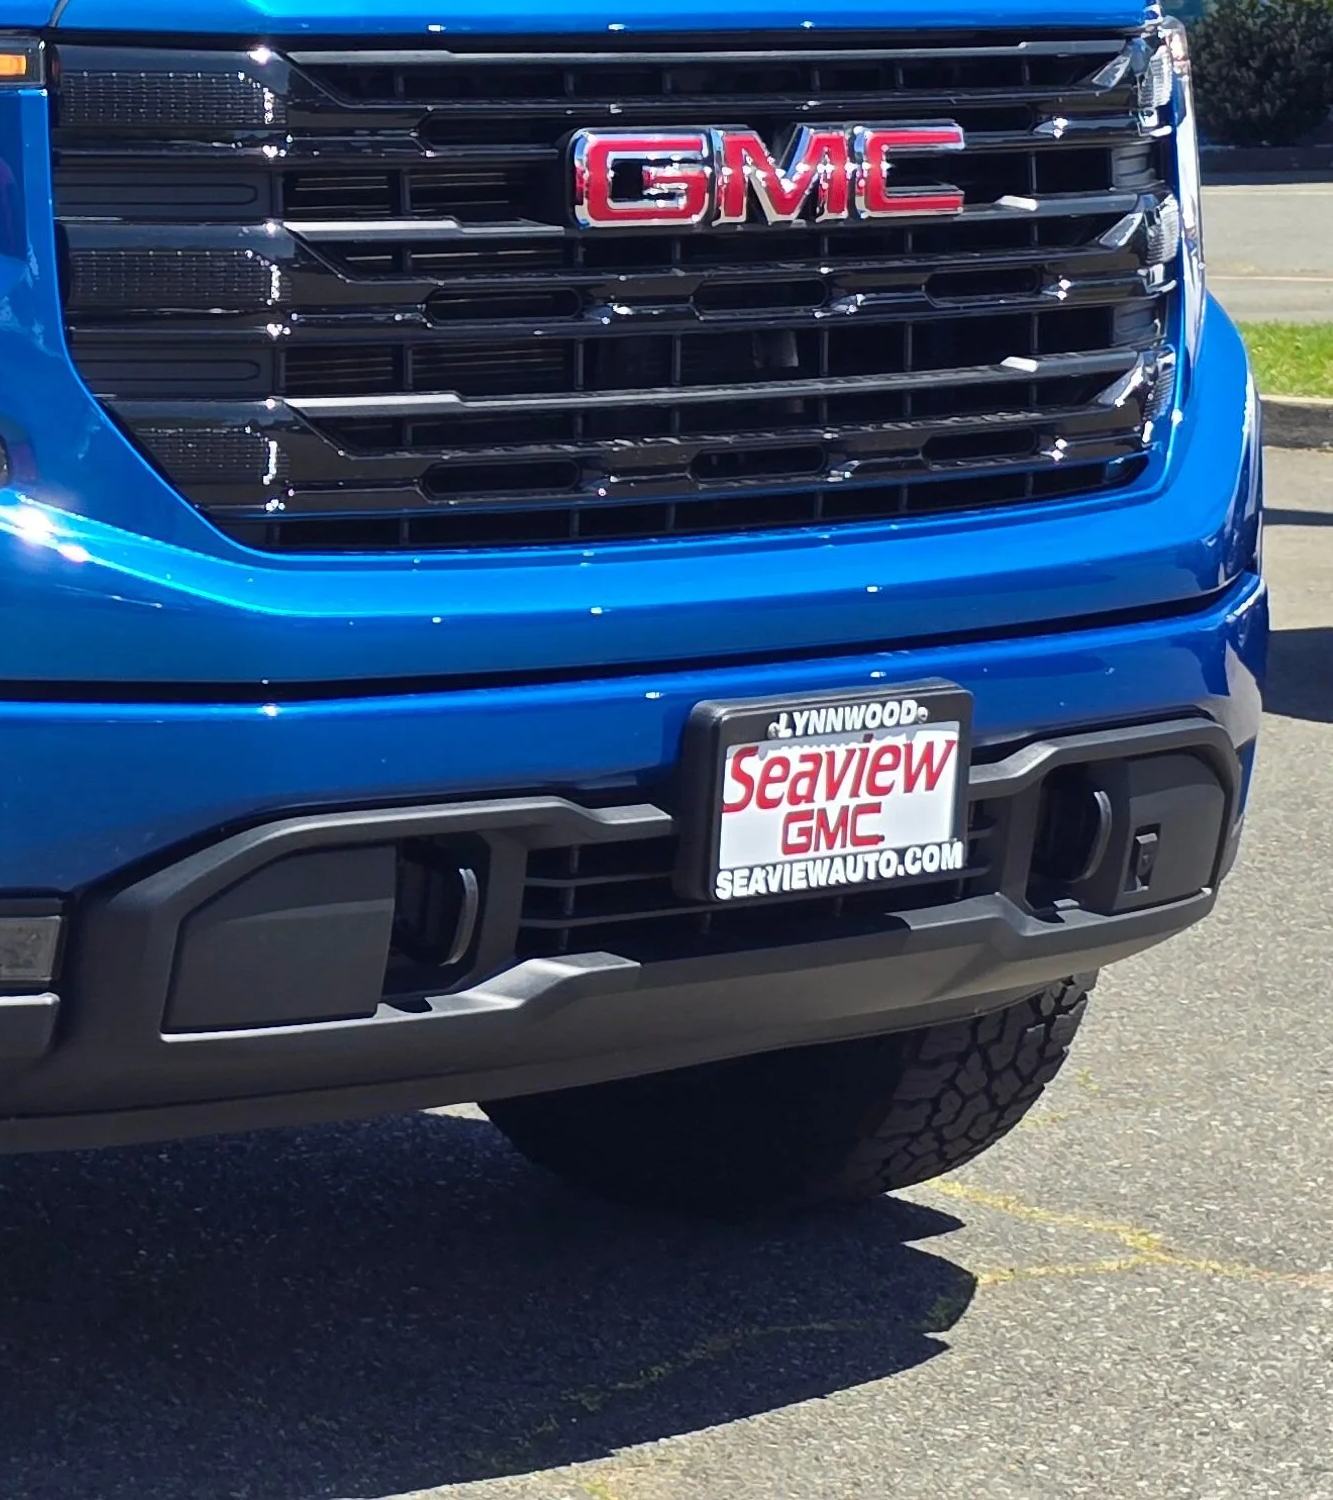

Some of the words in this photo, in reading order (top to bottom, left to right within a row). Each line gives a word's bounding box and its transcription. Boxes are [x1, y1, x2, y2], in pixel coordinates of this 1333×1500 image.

[572, 121, 965, 228] GMC
[777, 699, 918, 738] LYNNWOOD
[722, 733, 957, 814] Seaview
[781, 802, 885, 856] GMC
[715, 841, 964, 901] SEAVIEWAUTO.COM
